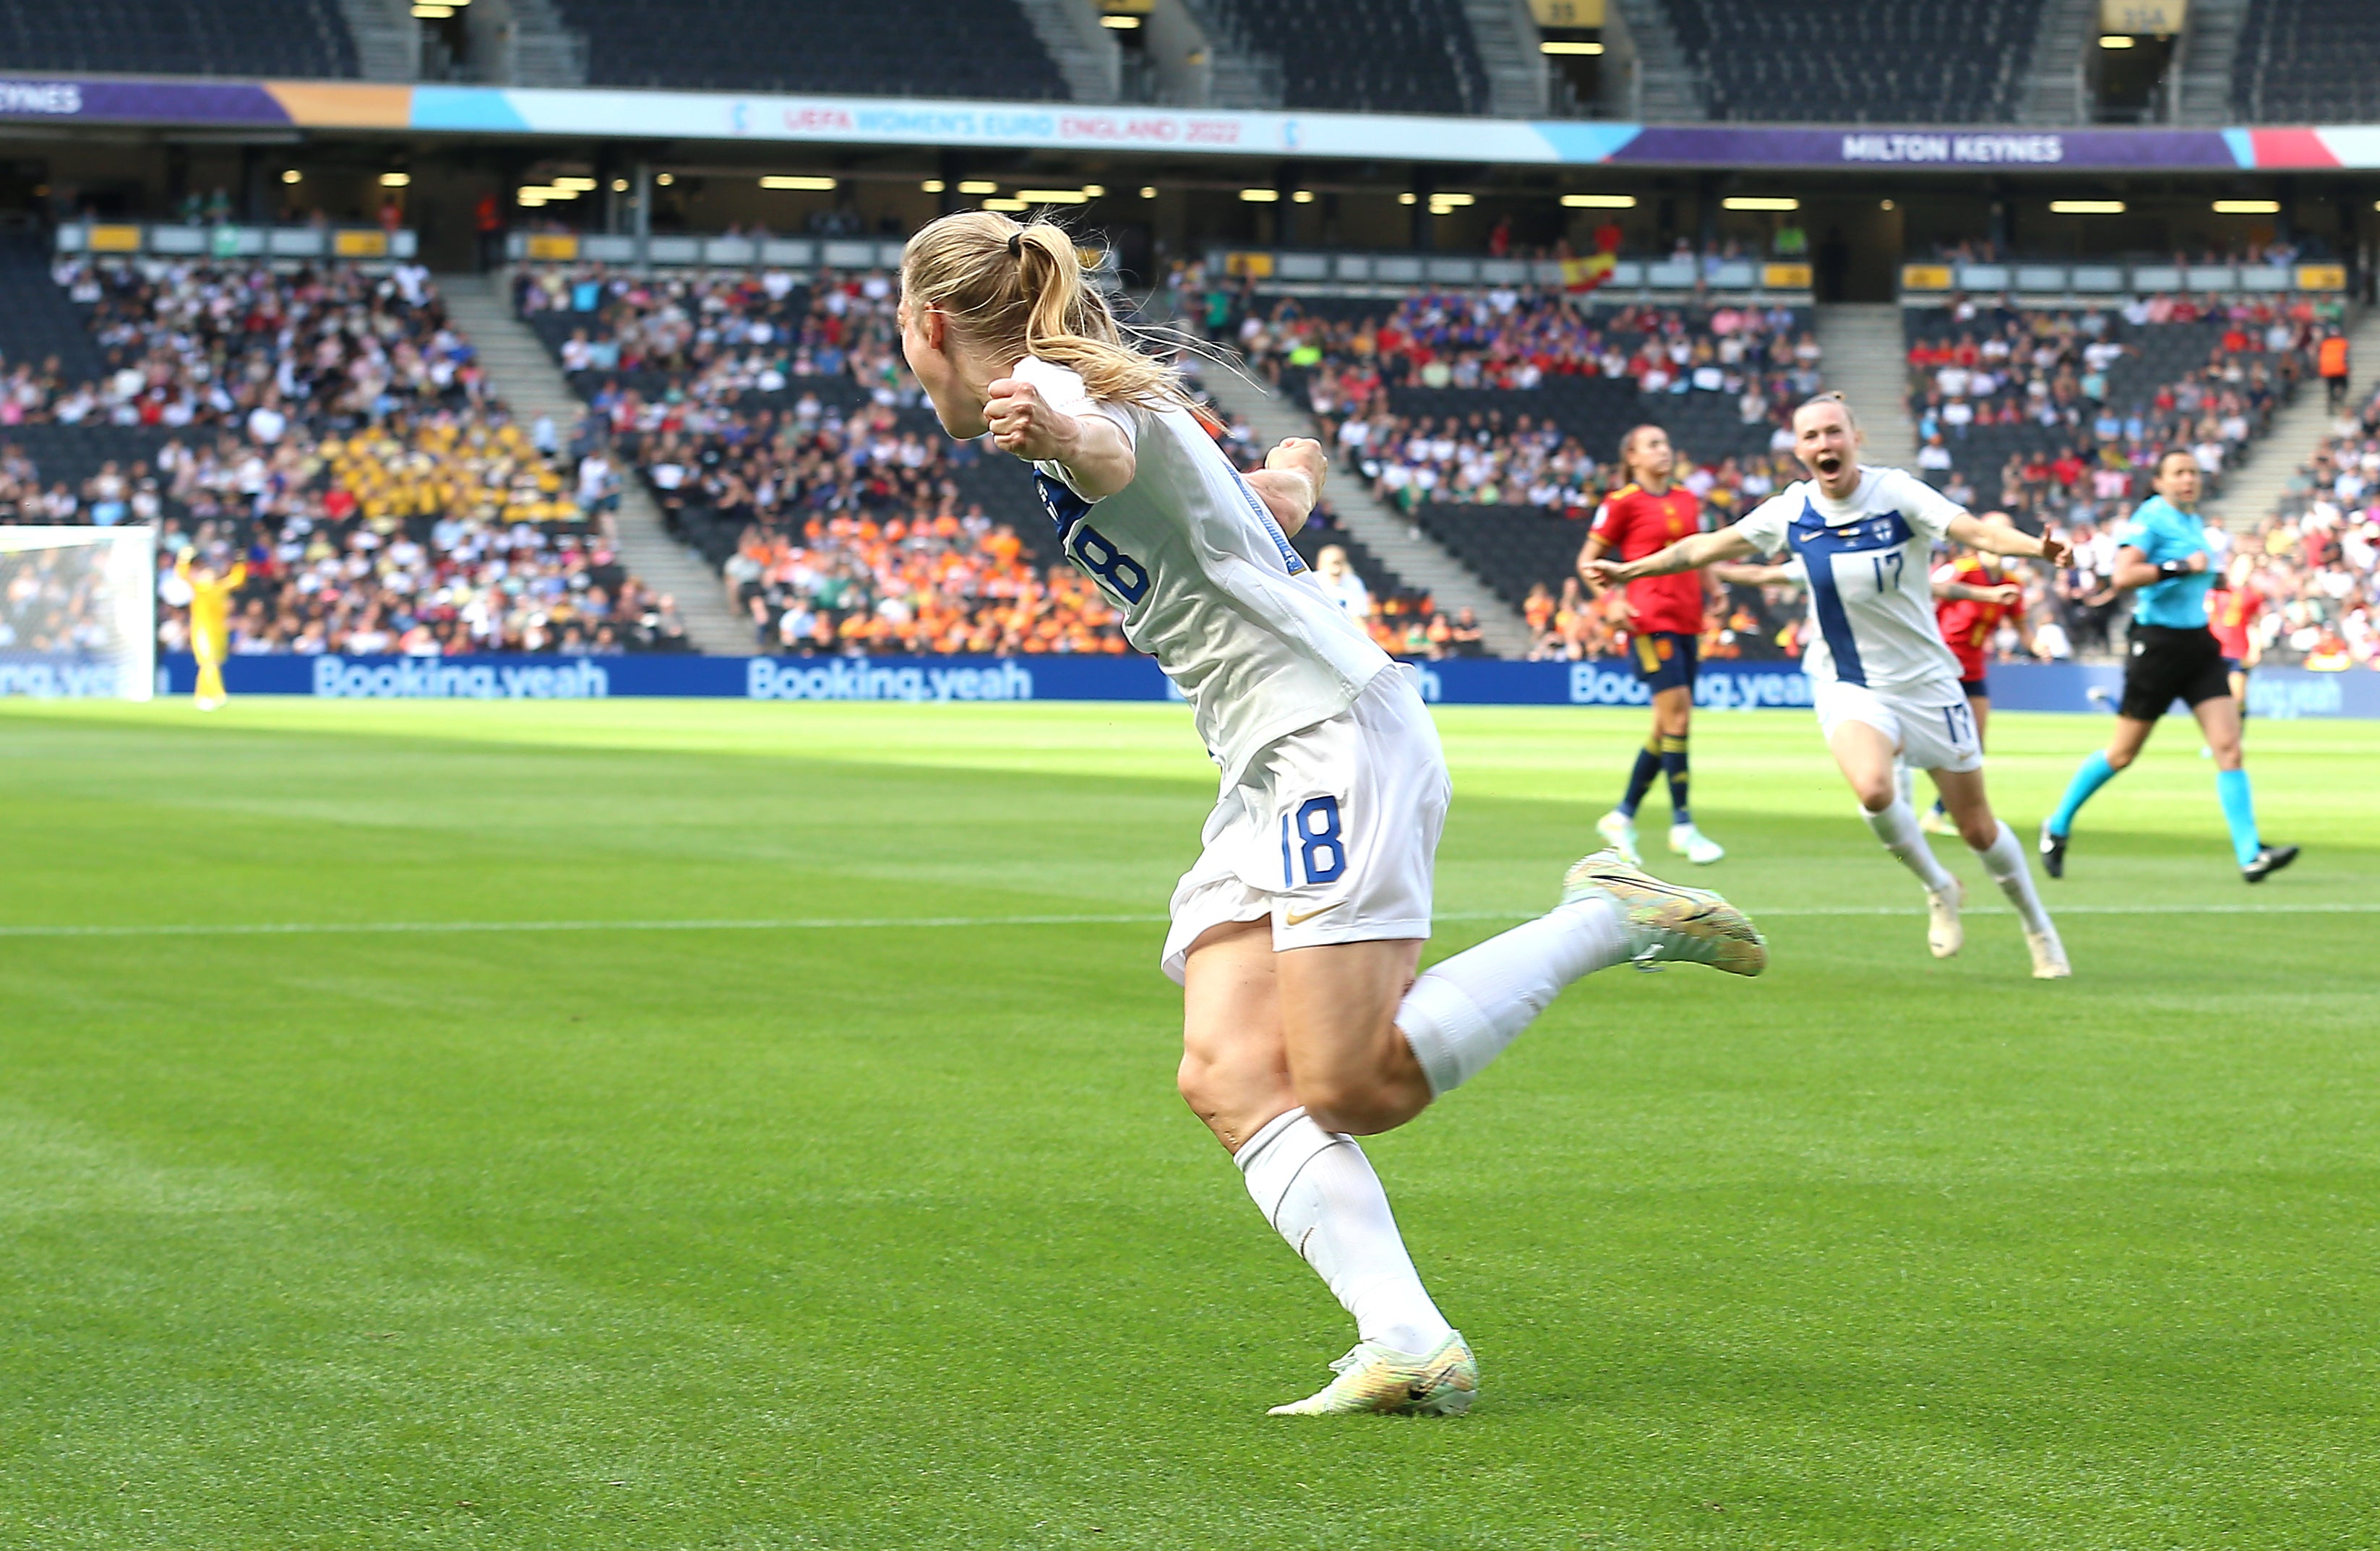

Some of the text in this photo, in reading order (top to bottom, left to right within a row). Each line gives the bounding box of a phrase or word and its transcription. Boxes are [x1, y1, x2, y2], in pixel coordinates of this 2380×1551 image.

[783, 107, 852, 132] UEFA
[983, 113, 1054, 140] EURO
[1060, 113, 1179, 142] ENGLAND
[1185, 119, 1241, 144] 2022
[1842, 134, 2063, 163] MILTON KEYNES
[1073, 524, 1151, 606] 8
[1873, 551, 1904, 594] 17
[313, 656, 609, 700] Booking.yeah
[747, 656, 1034, 703] Booking.yeah
[1281, 795, 1348, 889] 18
